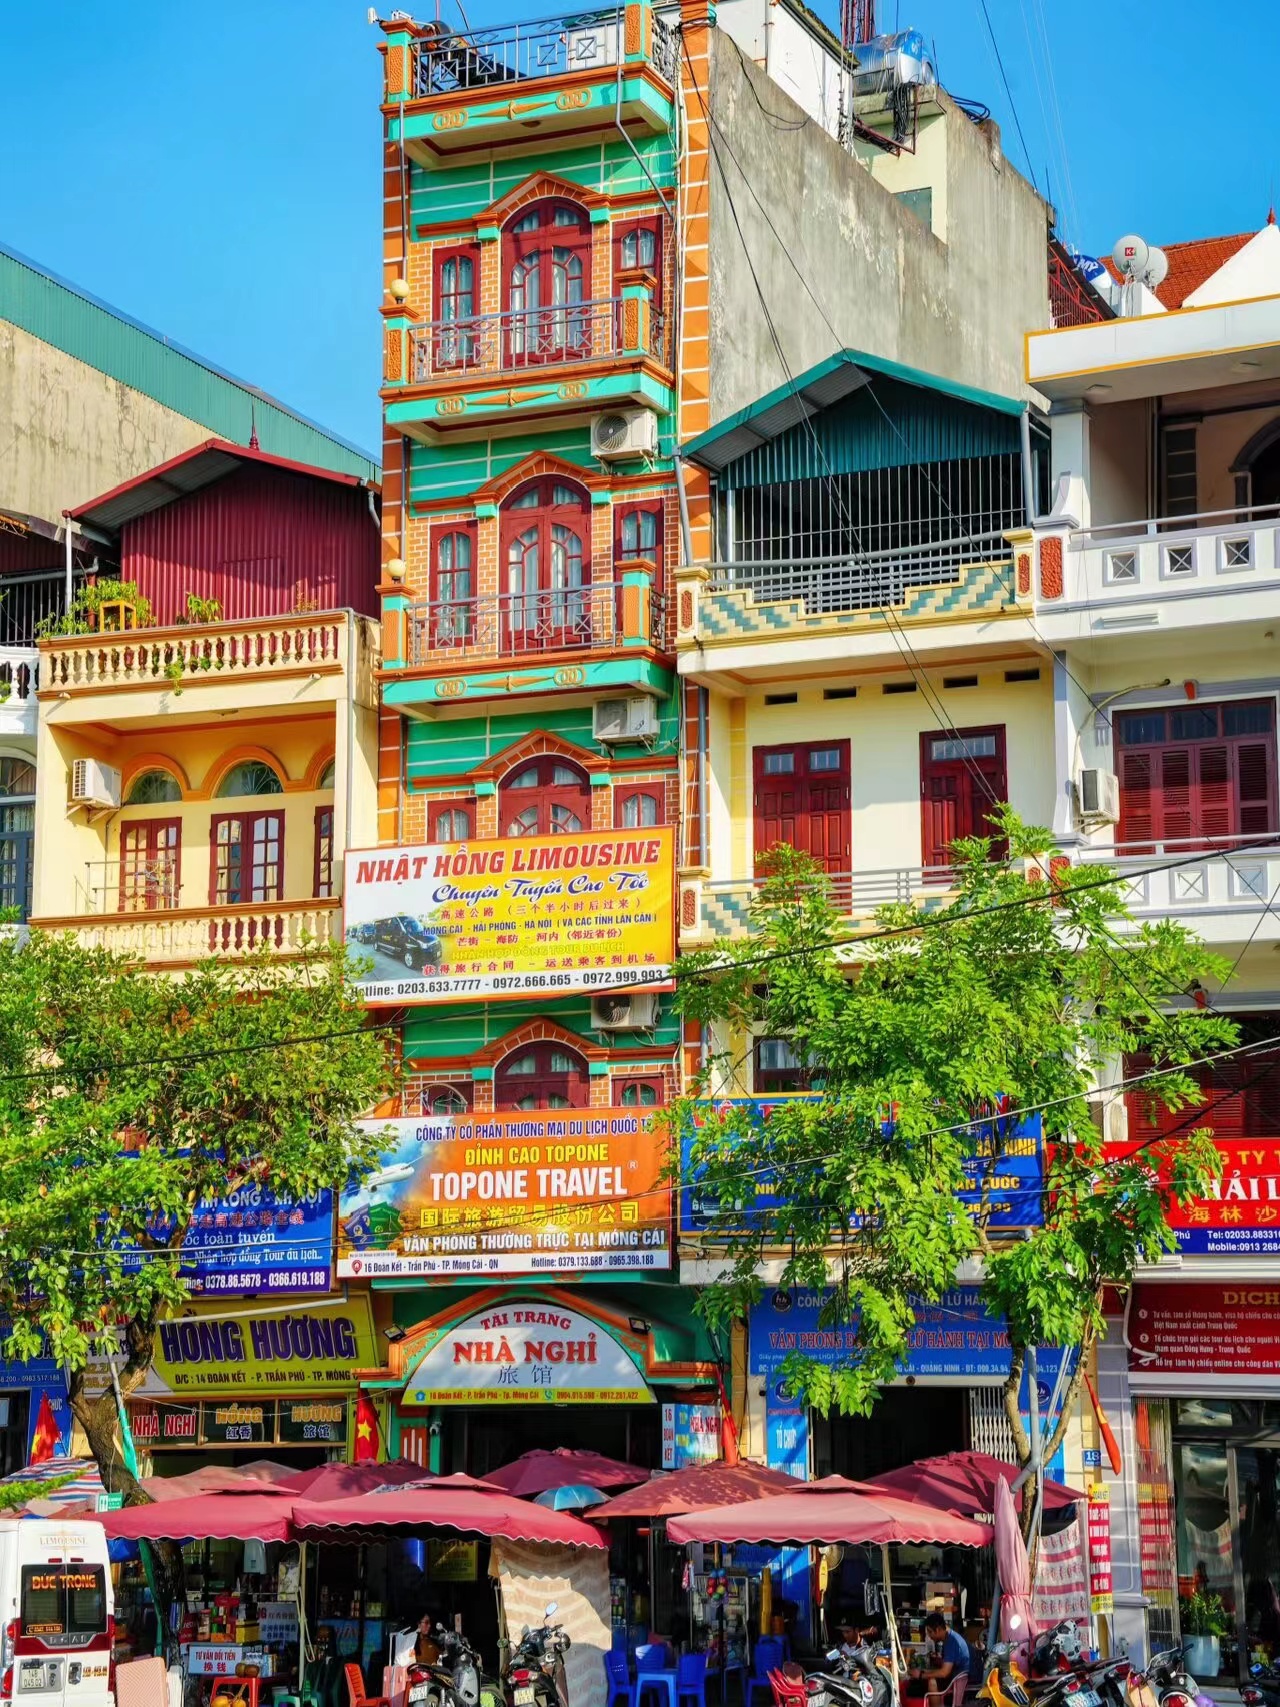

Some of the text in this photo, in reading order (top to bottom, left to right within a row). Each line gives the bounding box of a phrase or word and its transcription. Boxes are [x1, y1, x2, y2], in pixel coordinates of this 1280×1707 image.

[356, 840, 661, 885] NHẬT HỒNG LIMOUSINE
[505, 878, 563, 902] Tuyến
[568, 875, 604, 894] Cao
[609, 872, 648, 890] Tốc
[441, 907, 494, 920] 高速公路
[457, 936, 478, 947] 芒街
[496, 934, 518, 945] 海防
[536, 931, 559, 942] 河内
[551, 944, 580, 955] TOUR
[423, 960, 514, 976] 获得旅行合同
[398, 979, 481, 995] 0203.633.7777
[493, 974, 571, 989] 0972.666.665
[583, 969, 664, 984] 0972.999.993
[416, 1124, 442, 1141] CÔNG
[445, 1126, 456, 1140] TY
[459, 1119, 472, 1139] CỔ
[505, 1121, 544, 1137] THƯƠNG
[547, 1121, 566, 1140] MẠI
[570, 1121, 583, 1135] DU
[585, 1119, 608, 1139] LỊCH
[611, 1113, 637, 1135] QUỐC
[465, 1144, 608, 1165] ĐỈNH CAO TOPONE
[1237, 1151, 1266, 1165] TY
[430, 1166, 628, 1201] TOPONE TRAVEL
[421, 1201, 639, 1229] 国际旅游贸易股份公司
[404, 1234, 428, 1252] VĂN
[481, 1230, 532, 1249] THƯỜNG
[536, 1231, 569, 1250] TRỰC
[574, 1231, 594, 1250] TẠI
[642, 1226, 665, 1245] CÁI
[1207, 1230, 1224, 1239] Tel:
[264, 1248, 285, 1261] Tour
[488, 1258, 499, 1269] QN
[531, 1256, 557, 1268] Hotline:
[205, 1271, 325, 1290] 0378.86.5678 0366.619.188
[514, 1311, 572, 1331] TRANG
[250, 1314, 358, 1361] HƯƠNG
[768, 1328, 797, 1349] VĂN
[927, 1327, 964, 1349] HÀNH
[967, 1330, 990, 1353] TẠI
[453, 1331, 597, 1364] NHÀ NGHỈ
[256, 1371, 264, 1383] P.
[312, 1370, 324, 1381] TP.
[497, 1364, 553, 1385] 旅馆
[133, 1407, 197, 1437] NHÀ NGHỈ
[291, 1404, 342, 1422] HƯƠNG
[1085, 1451, 1100, 1460] 18
[60, 1574, 96, 1591] TRỌNG
[203, 1662, 227, 1673] 换钱
